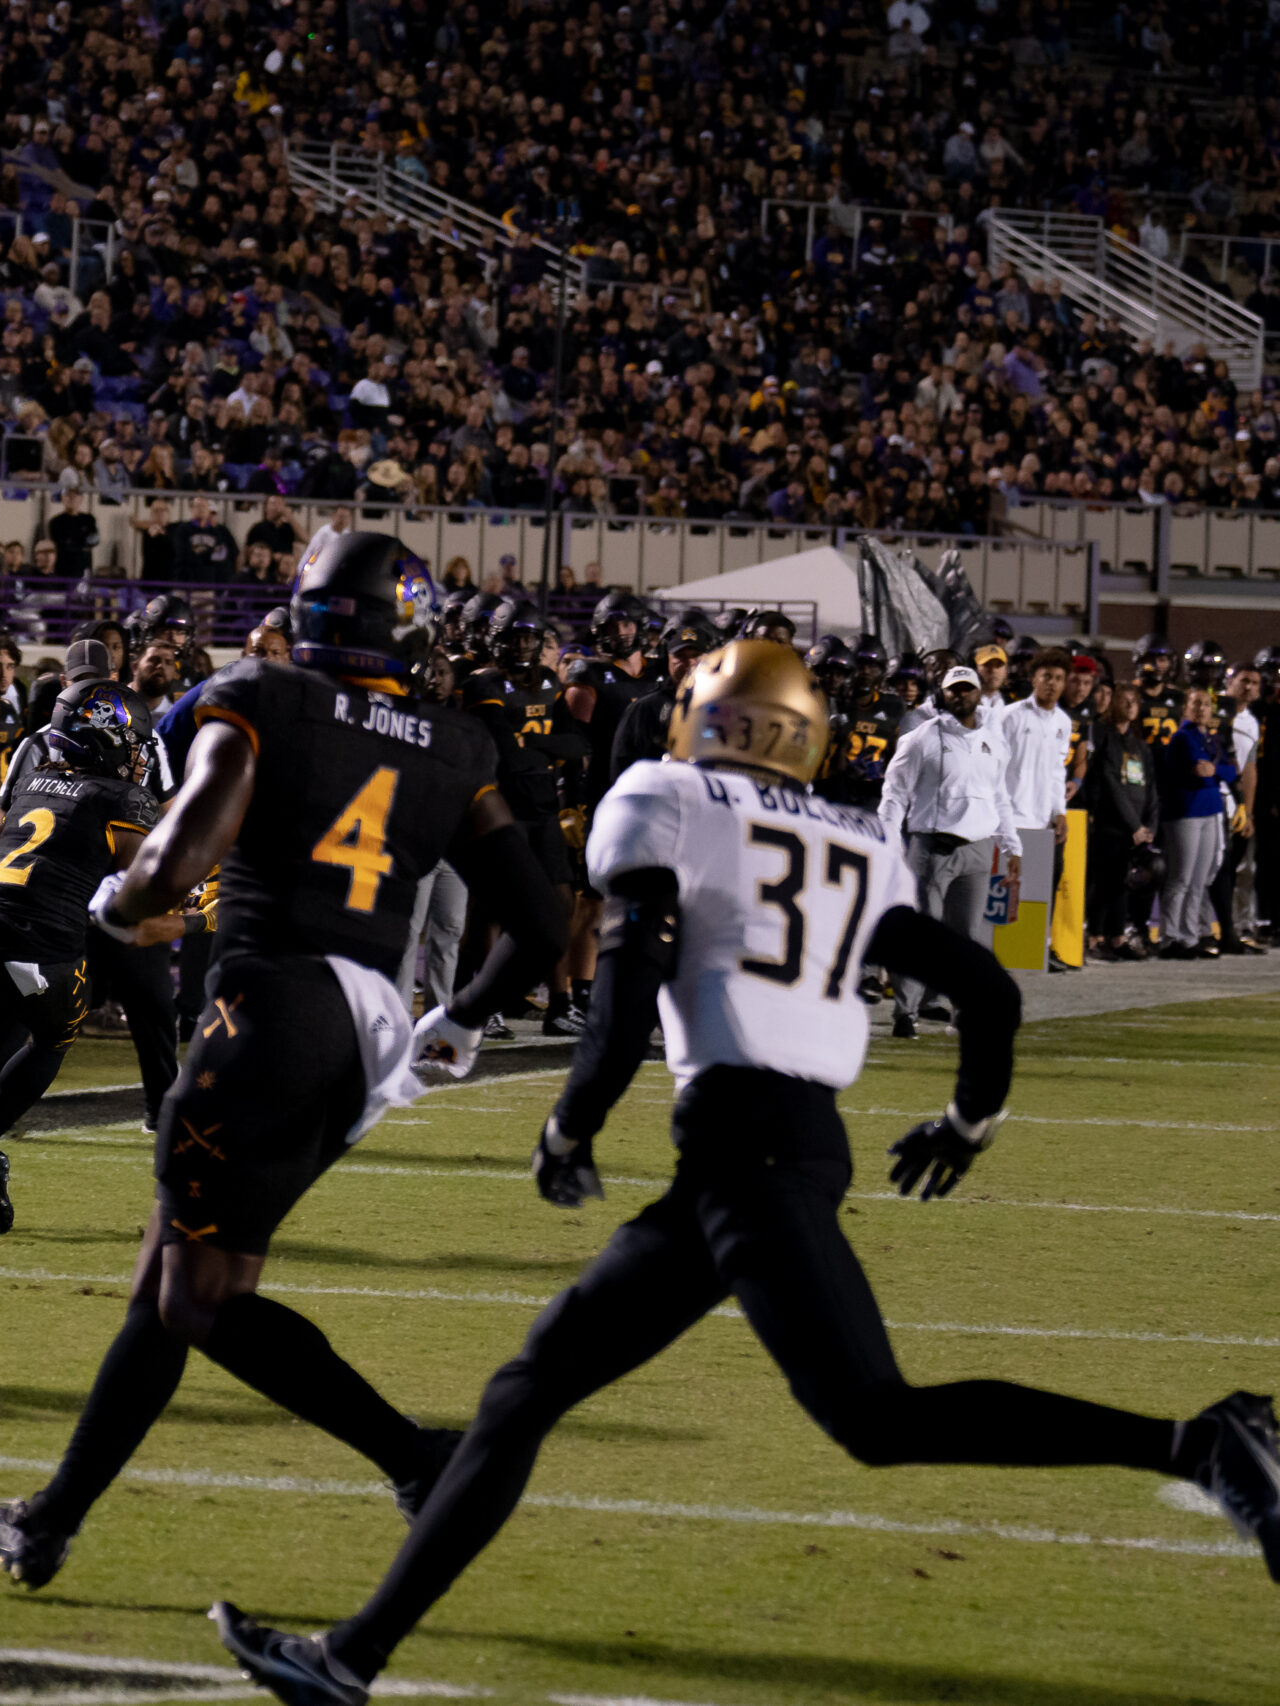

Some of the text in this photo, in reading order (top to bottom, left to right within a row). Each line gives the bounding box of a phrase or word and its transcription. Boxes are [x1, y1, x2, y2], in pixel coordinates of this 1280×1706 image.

[334, 692, 433, 748] R. JONES
[26, 776, 85, 798] MITCHELL
[310, 765, 401, 915] 4
[738, 821, 871, 1000] 37
